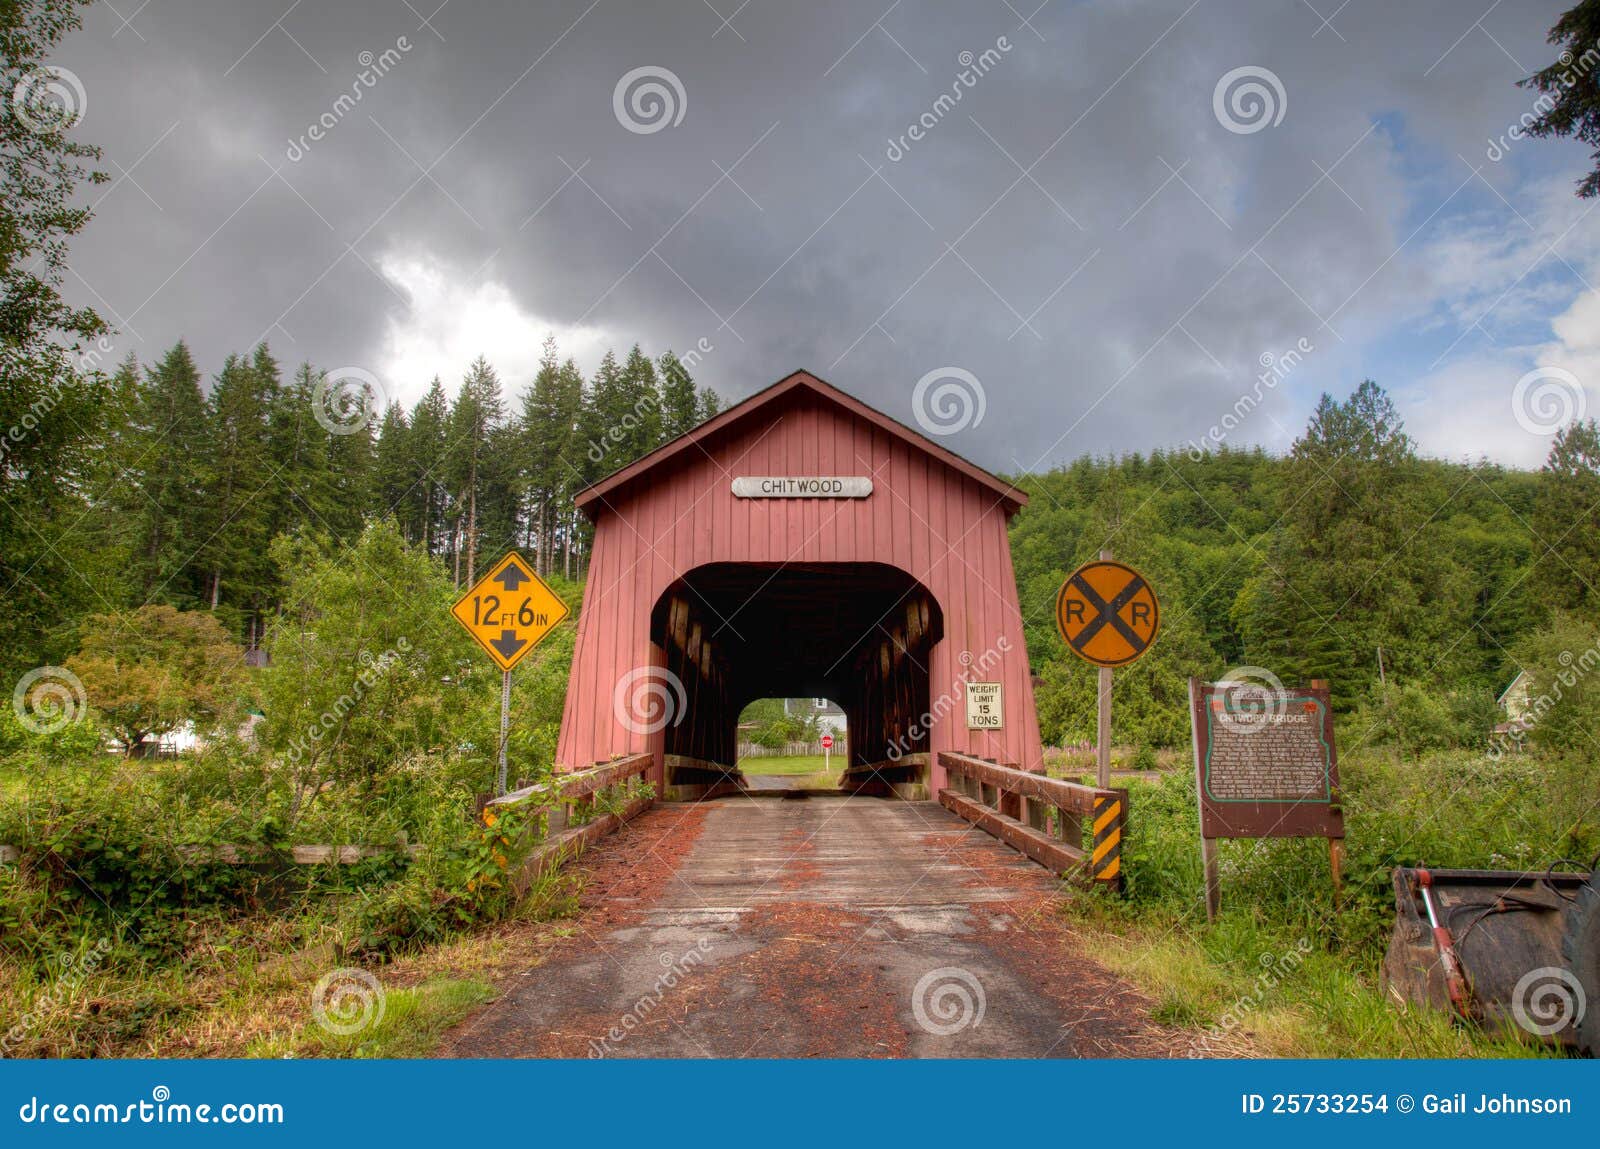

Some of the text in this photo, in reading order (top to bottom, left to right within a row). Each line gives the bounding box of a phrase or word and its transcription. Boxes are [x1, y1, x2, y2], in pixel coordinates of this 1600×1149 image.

[761, 480, 843, 493] CHITWOOD
[473, 595, 549, 627] 12 FT 6 IN
[1066, 599, 1151, 627] R R
[969, 685, 999, 694] WEIGHT
[974, 695, 994, 703] LIMIT
[979, 704, 990, 714] 15
[972, 715, 999, 725] TONS
[1268, 714, 1309, 723] BRIDGE
